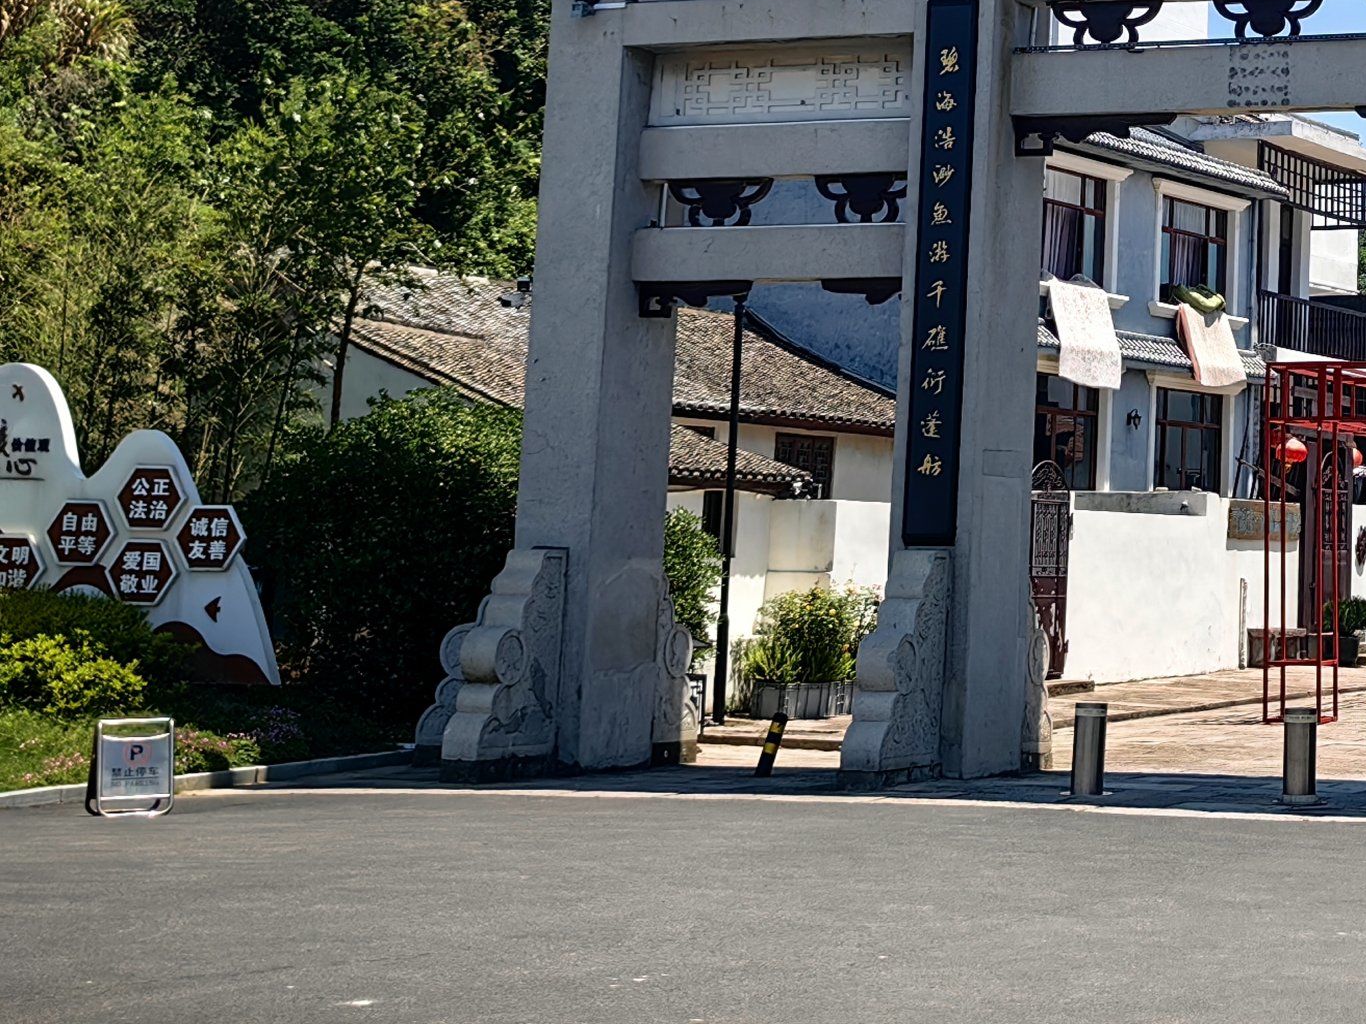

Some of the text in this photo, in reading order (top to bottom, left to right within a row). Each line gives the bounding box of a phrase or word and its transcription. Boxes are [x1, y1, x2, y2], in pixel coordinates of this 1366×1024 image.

[131, 477, 170, 496] 公正
[129, 500, 168, 519] 法治
[62, 511, 97, 532] 自由
[190, 517, 229, 537] 诚信
[58, 535, 96, 555] 平等
[188, 539, 227, 560] 友善
[122, 551, 161, 571] 爱国
[120, 574, 158, 593] 敬业
